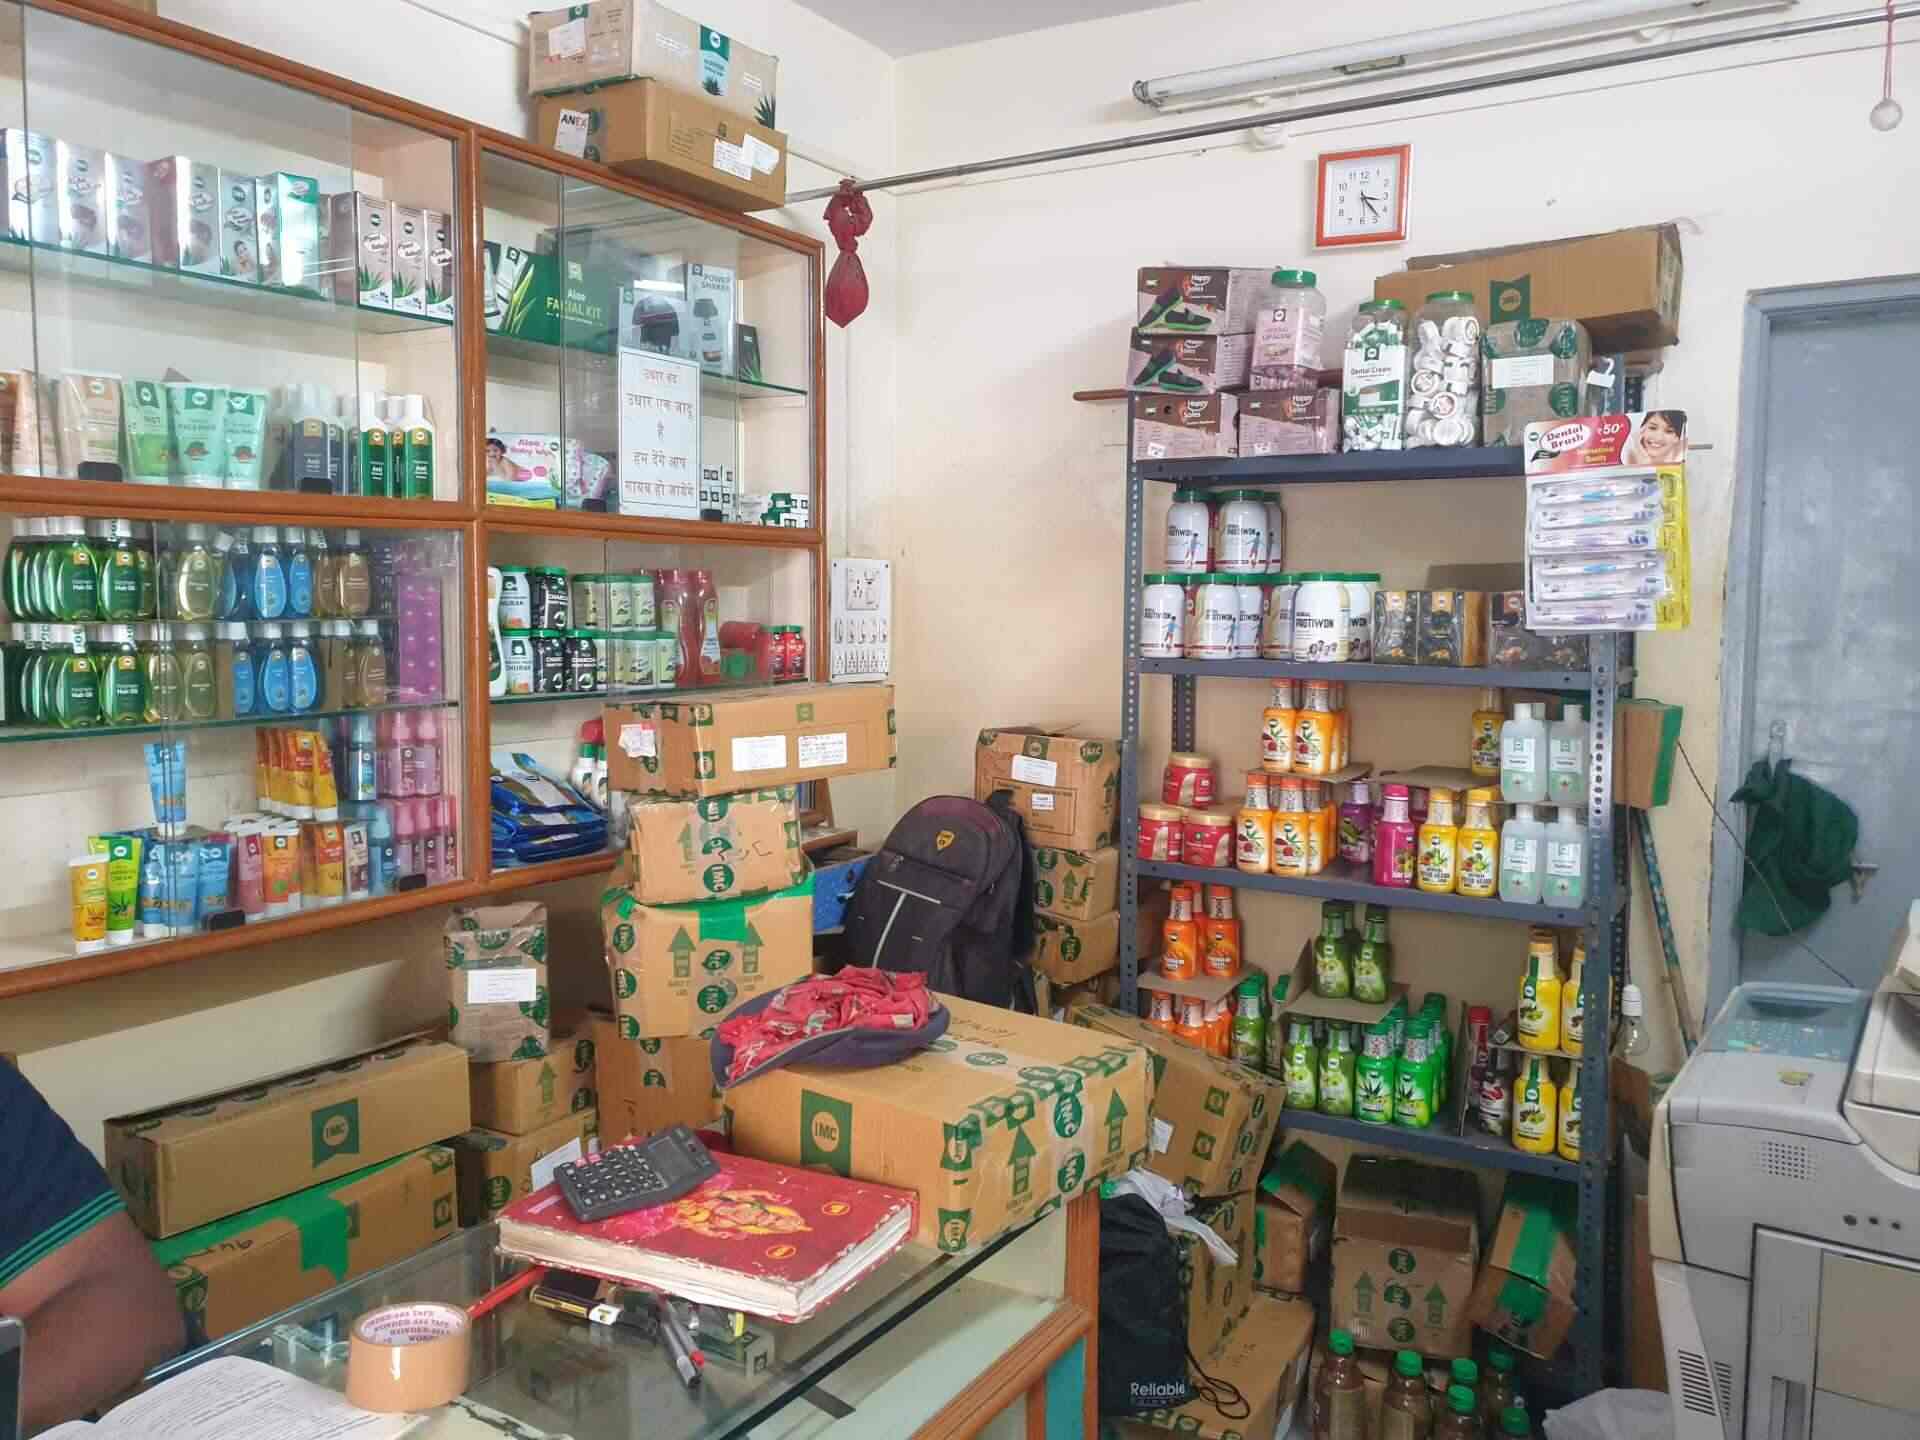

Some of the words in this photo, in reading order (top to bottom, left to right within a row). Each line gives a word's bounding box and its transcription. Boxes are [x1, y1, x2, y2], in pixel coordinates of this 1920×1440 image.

[1546, 424, 1583, 441] Dental
[1551, 435, 1584, 449] Brush
[711, 863, 726, 892] IMC
[815, 1121, 837, 1142] IMC
